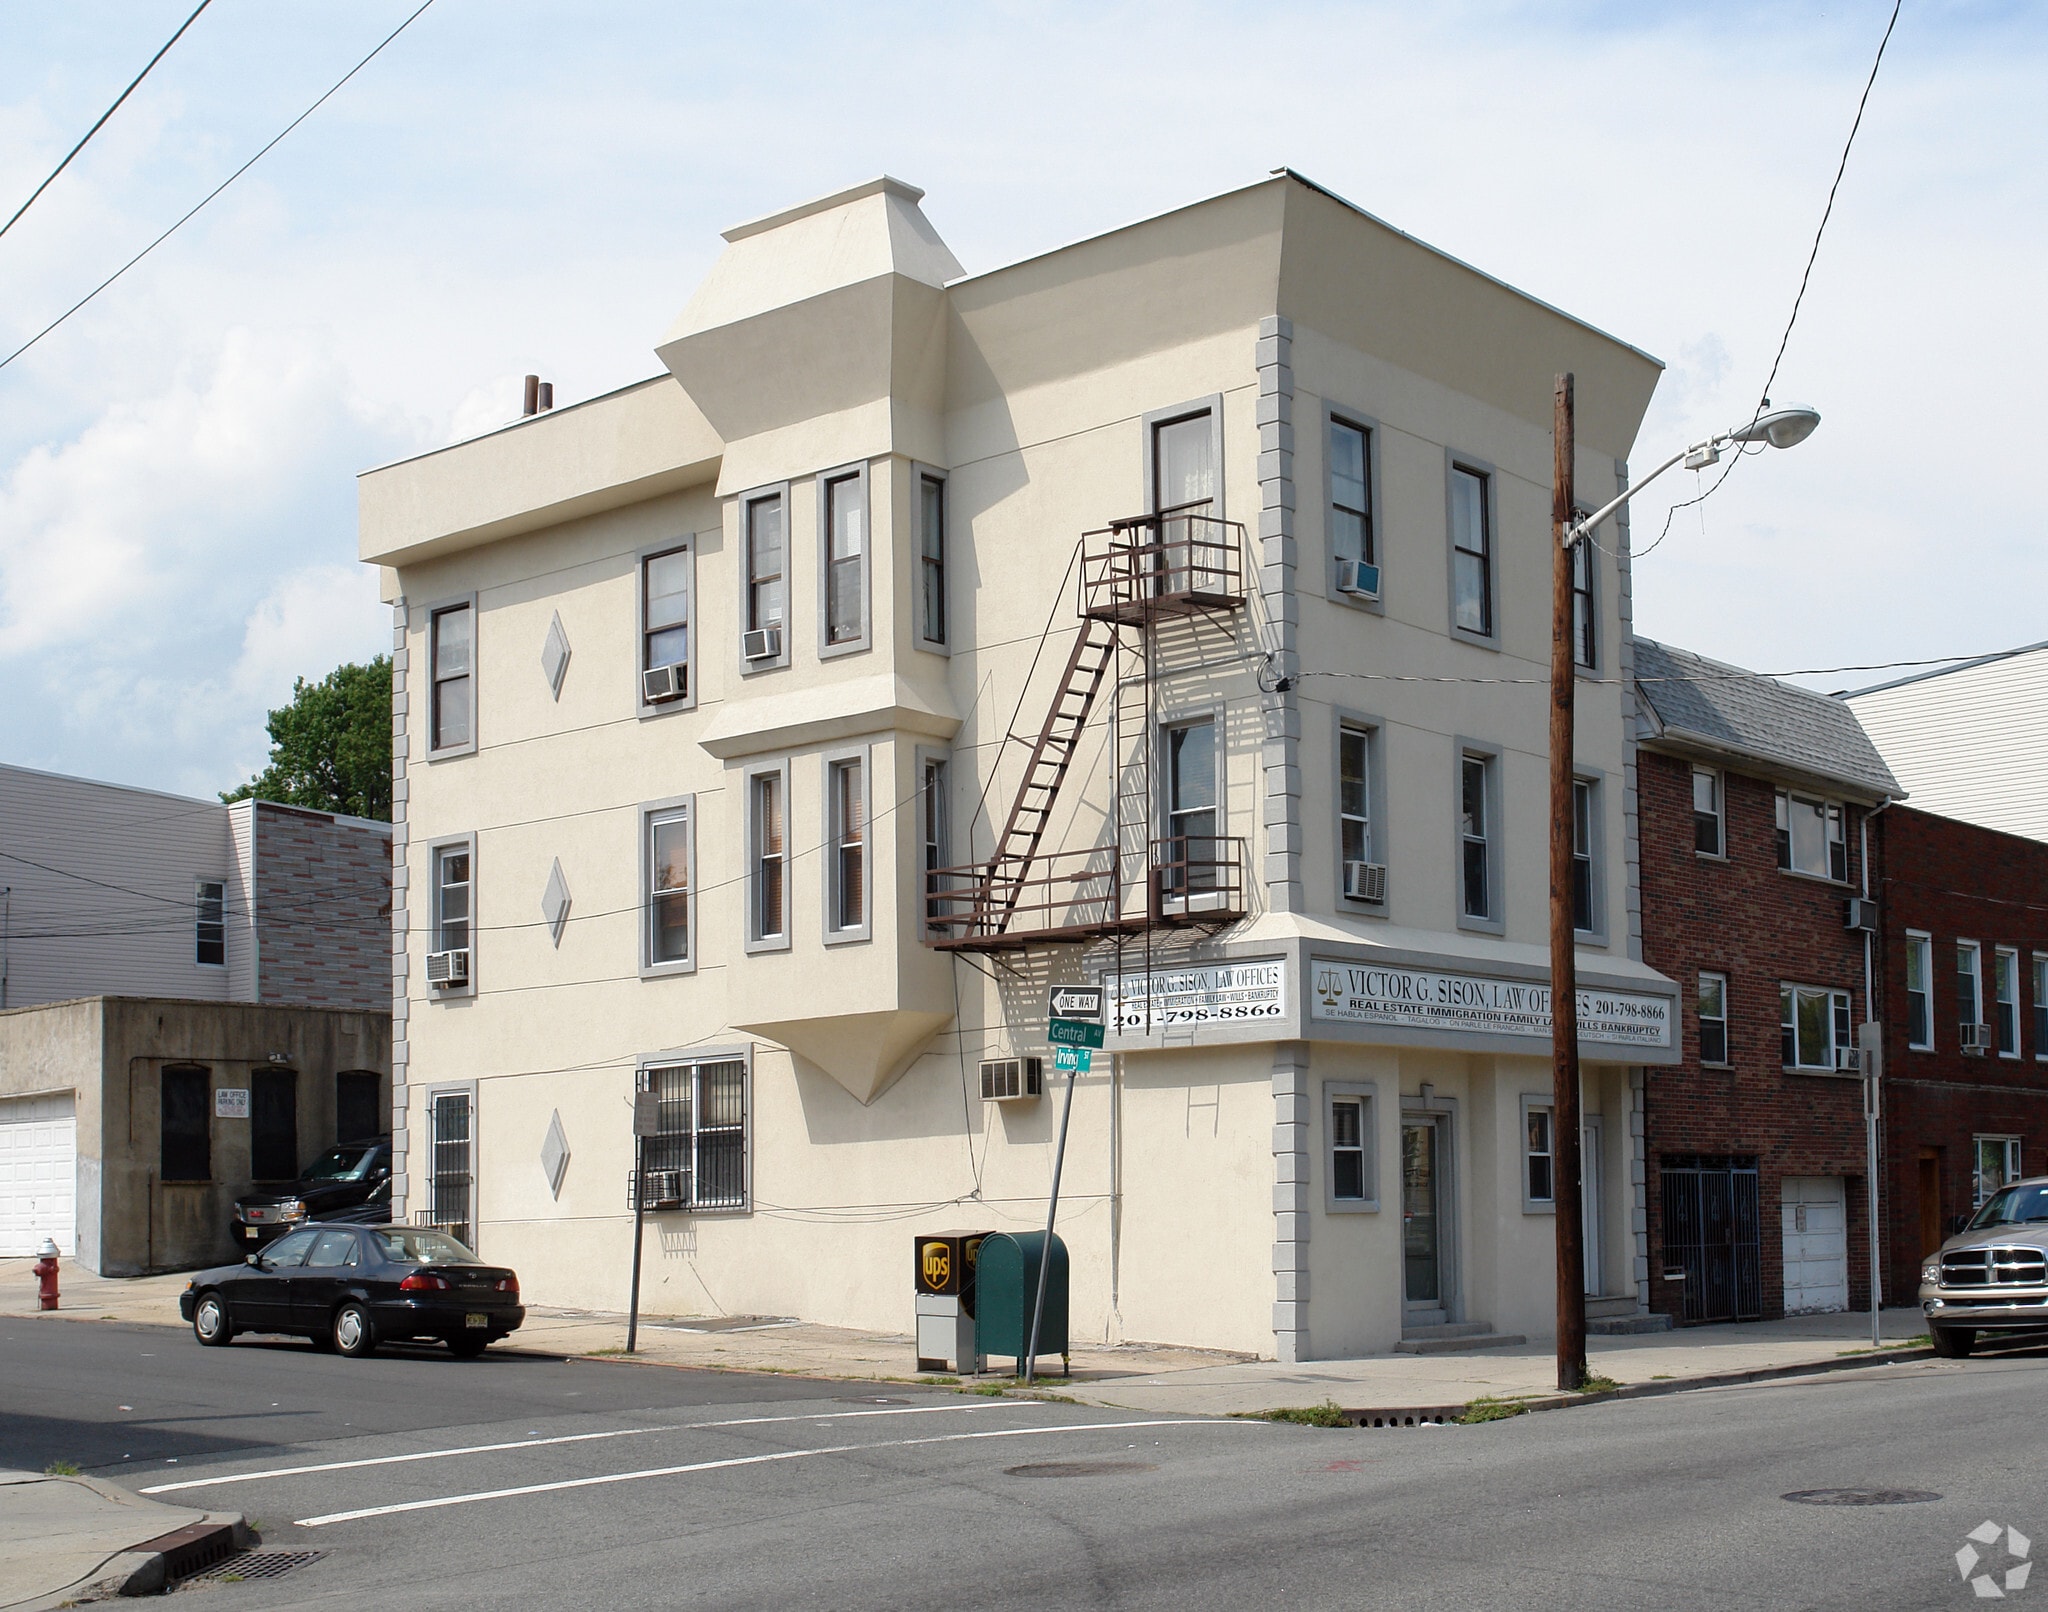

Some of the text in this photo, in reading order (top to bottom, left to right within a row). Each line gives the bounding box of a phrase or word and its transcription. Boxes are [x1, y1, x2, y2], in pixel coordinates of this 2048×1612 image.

[1179, 972, 1210, 991] SISON,
[1215, 970, 1234, 988] LAW
[1236, 966, 1279, 987] OFFICES
[1060, 996, 1096, 1009] ONE WAY
[1230, 991, 1245, 1002] WILLS
[1247, 989, 1279, 1000] BANKRUPTCY
[1347, 969, 1412, 1001] VICTOR
[1416, 976, 1433, 1002] G.
[1438, 979, 1489, 1009] SISON,
[1493, 985, 1525, 1010] LAW
[1595, 999, 1665, 1020] 201-798-8866
[1325, 1008, 1336, 1016] SE
[1337, 1010, 1363, 1018] HABLA
[1408, 1016, 1440, 1025] TAGALOG
[1449, 1019, 1460, 1027] ON
[1461, 1020, 1482, 1029] PARLE
[1350, 1000, 1380, 1011] REAL
[1383, 1002, 1423, 1015] ESTATE
[1427, 1006, 1500, 1021] IMMIGRATION
[1504, 1014, 1540, 1025] FAMILY
[1601, 1023, 1660, 1035] BANKRUPTCY
[1051, 1023, 1087, 1042] Central
[1057, 1049, 1079, 1069] Irving
[926, 1257, 947, 1282] ups
